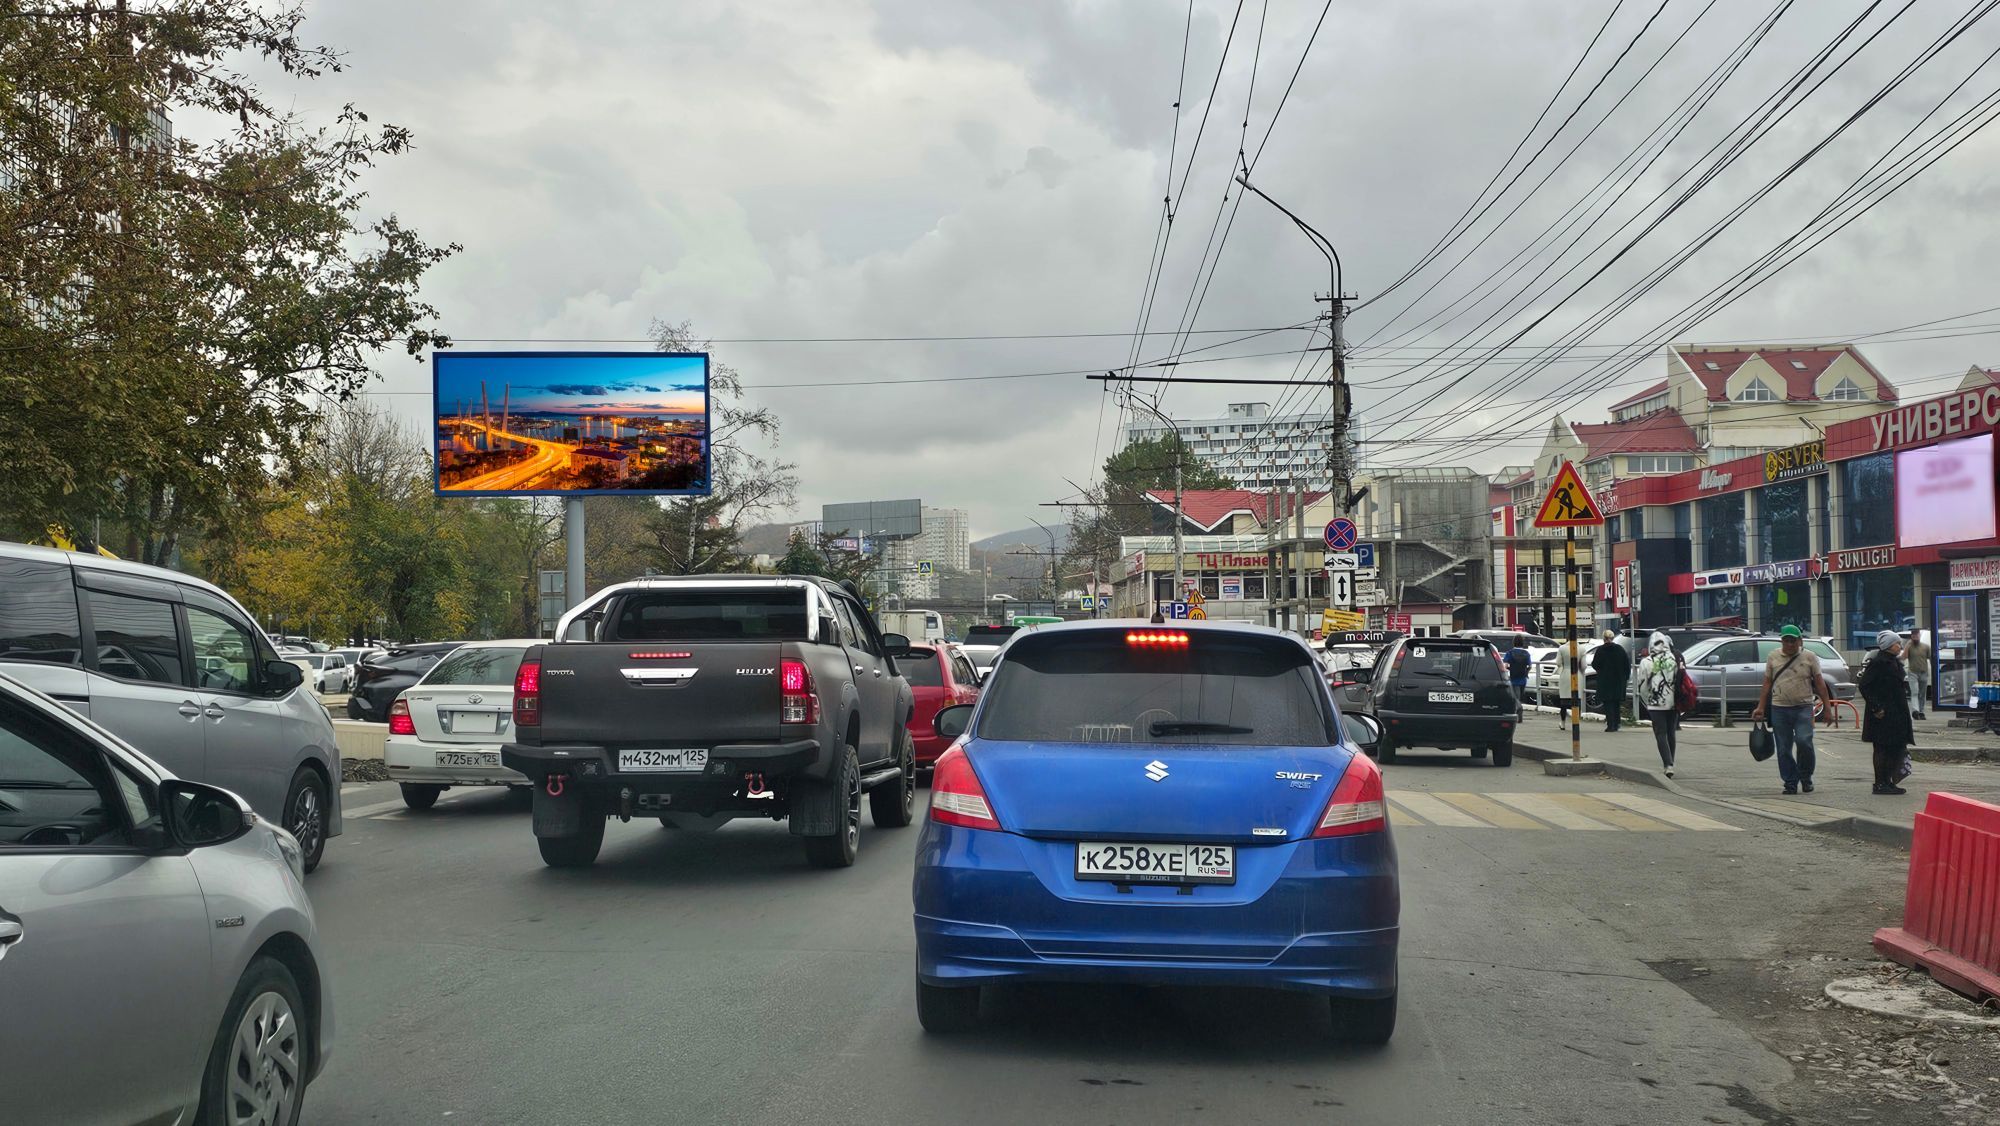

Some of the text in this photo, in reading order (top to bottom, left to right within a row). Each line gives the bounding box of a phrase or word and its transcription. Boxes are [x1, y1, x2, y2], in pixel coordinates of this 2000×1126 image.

[1196, 552, 1218, 568] ТЦ
[1360, 548, 1369, 563] P
[1838, 547, 1895, 569] SUNLIGHT
[1175, 604, 1184, 619] P
[1345, 630, 1384, 641] maxim
[736, 668, 775, 676] HILUX
[440, 754, 497, 765] К725ЕХ 125
[623, 750, 704, 766] М432ММ 125
[1275, 771, 1323, 781] SWIFT
[1086, 846, 1227, 872] К258ХЕ 125
[1197, 866, 1216, 874] RUS
